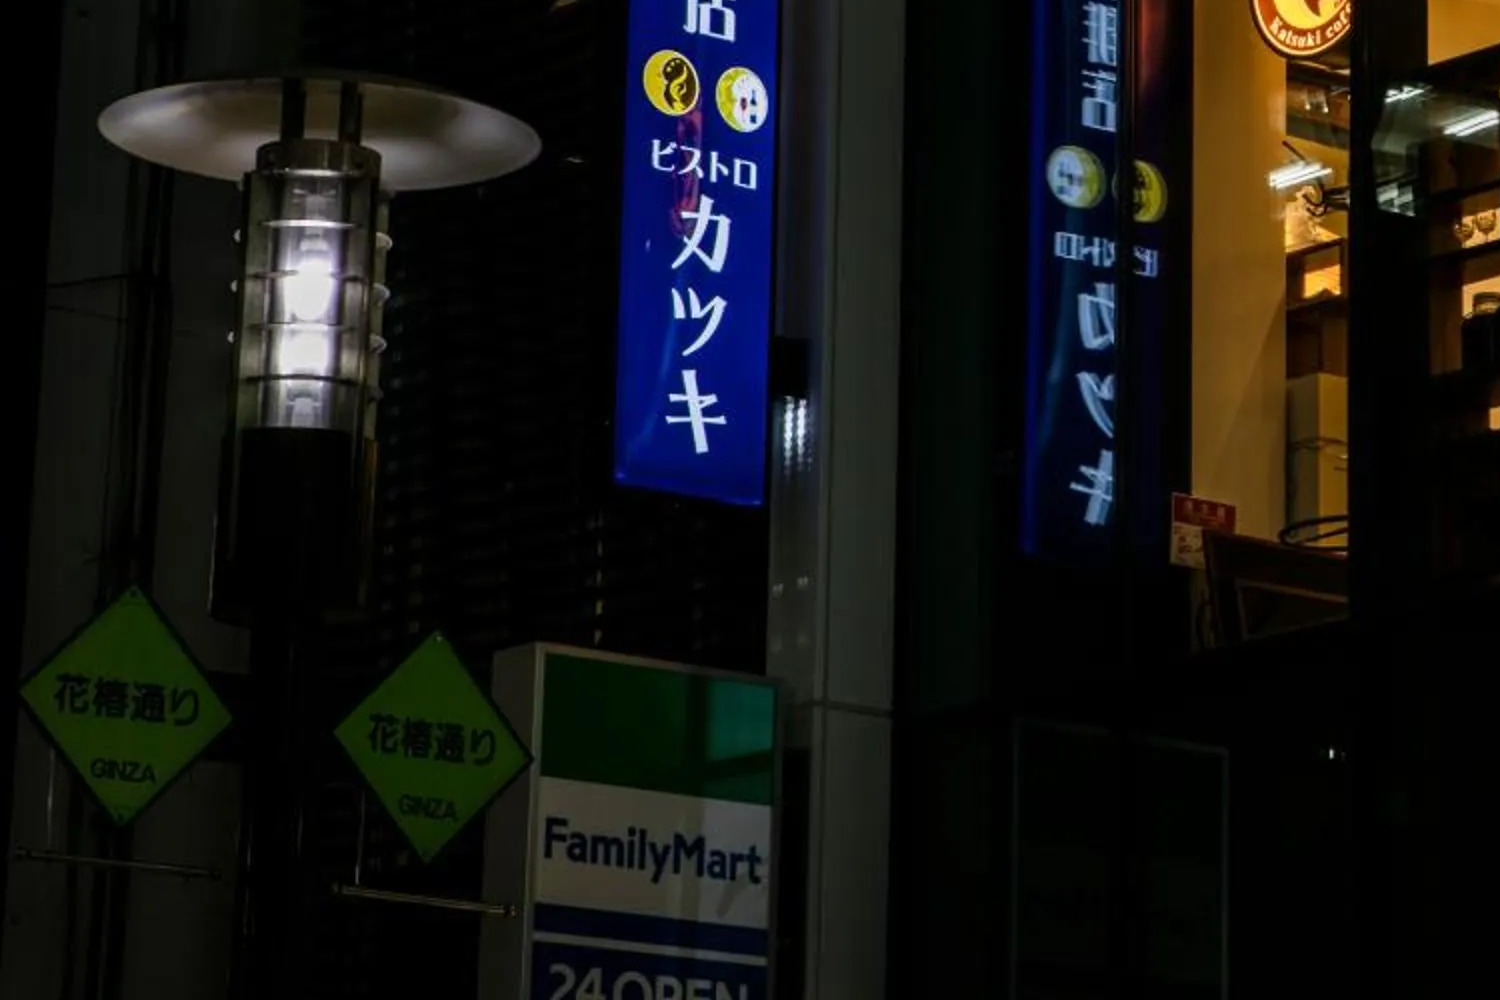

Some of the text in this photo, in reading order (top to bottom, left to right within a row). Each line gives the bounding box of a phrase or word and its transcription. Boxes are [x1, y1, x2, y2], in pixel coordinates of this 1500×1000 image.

[651, 138, 758, 191] ビストロ
[665, 194, 733, 454] カツキ
[54, 672, 200, 728] 花椿通り
[368, 713, 498, 767] 花椿通り
[89, 757, 157, 786] GINZA
[400, 793, 461, 824] GINZA
[544, 816, 762, 884] FamilyMart
